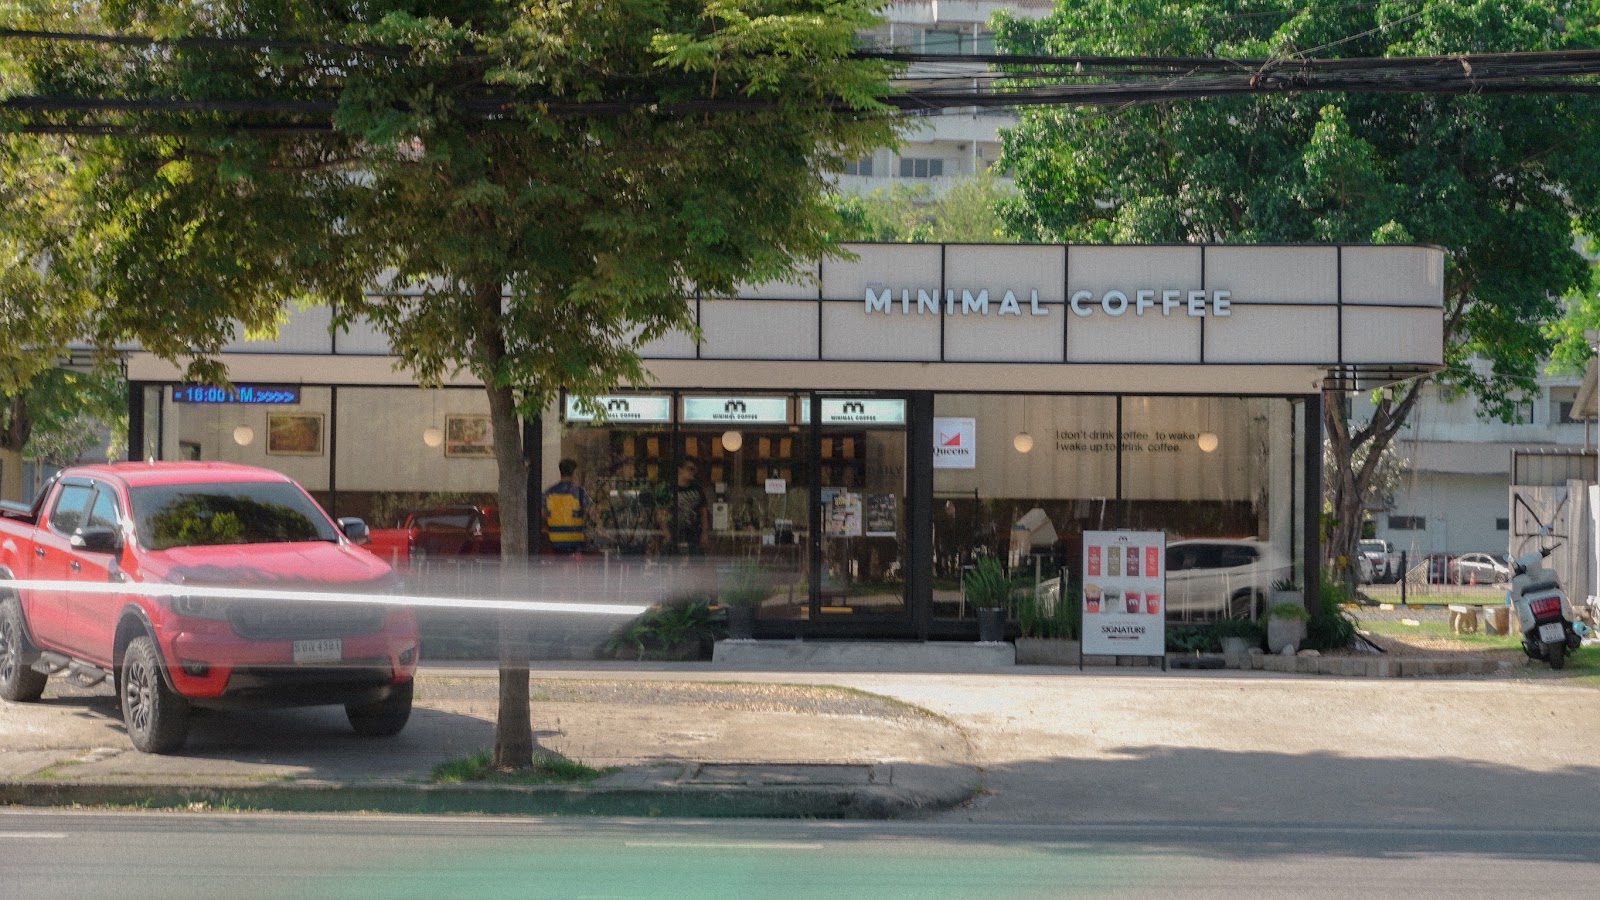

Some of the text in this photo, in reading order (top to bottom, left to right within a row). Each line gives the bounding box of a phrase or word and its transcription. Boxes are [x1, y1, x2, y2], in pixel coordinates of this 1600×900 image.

[864, 288, 1232, 317] MINIMAL COFFEE
[1061, 430, 1087, 439] don't
[1089, 430, 1114, 440] drink
[1120, 430, 1148, 440] offee
[1156, 431, 1166, 440] to
[1169, 431, 1195, 440] wake
[933, 446, 969, 456] Queens
[1061, 441, 1087, 451] wake
[1090, 443, 1102, 453] up
[1105, 442, 1116, 451] to
[1101, 625, 1146, 634] SIGNATURE
